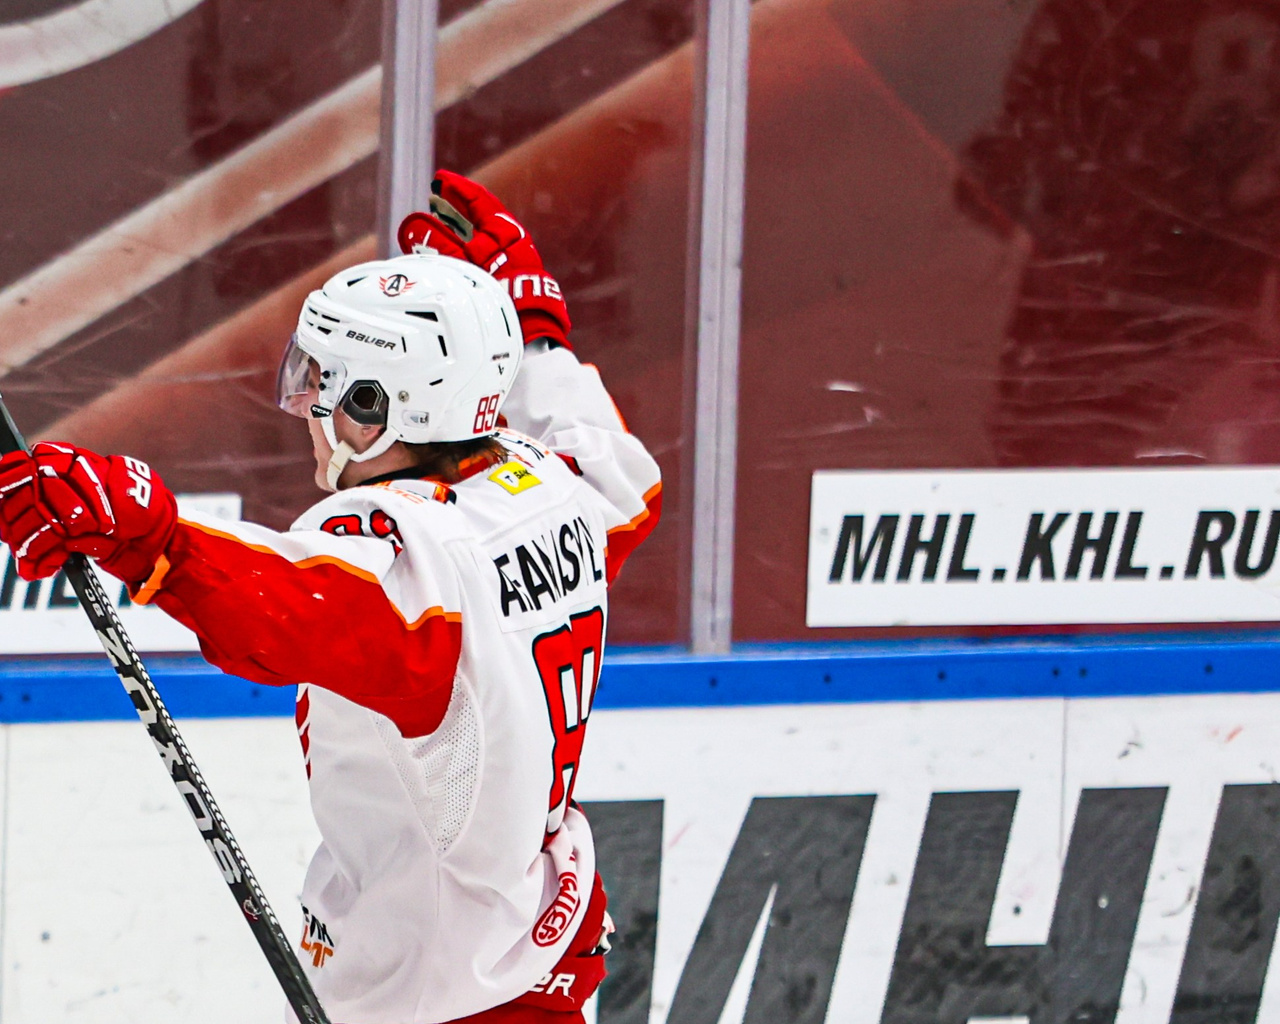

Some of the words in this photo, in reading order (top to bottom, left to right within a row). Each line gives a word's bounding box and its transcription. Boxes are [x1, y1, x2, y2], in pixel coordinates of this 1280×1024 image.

[345, 329, 397, 351] BAUER
[312, 405, 330, 416] CCM
[472, 393, 500, 434] 89
[827, 509, 1280, 584] MHL.KHL.RU
